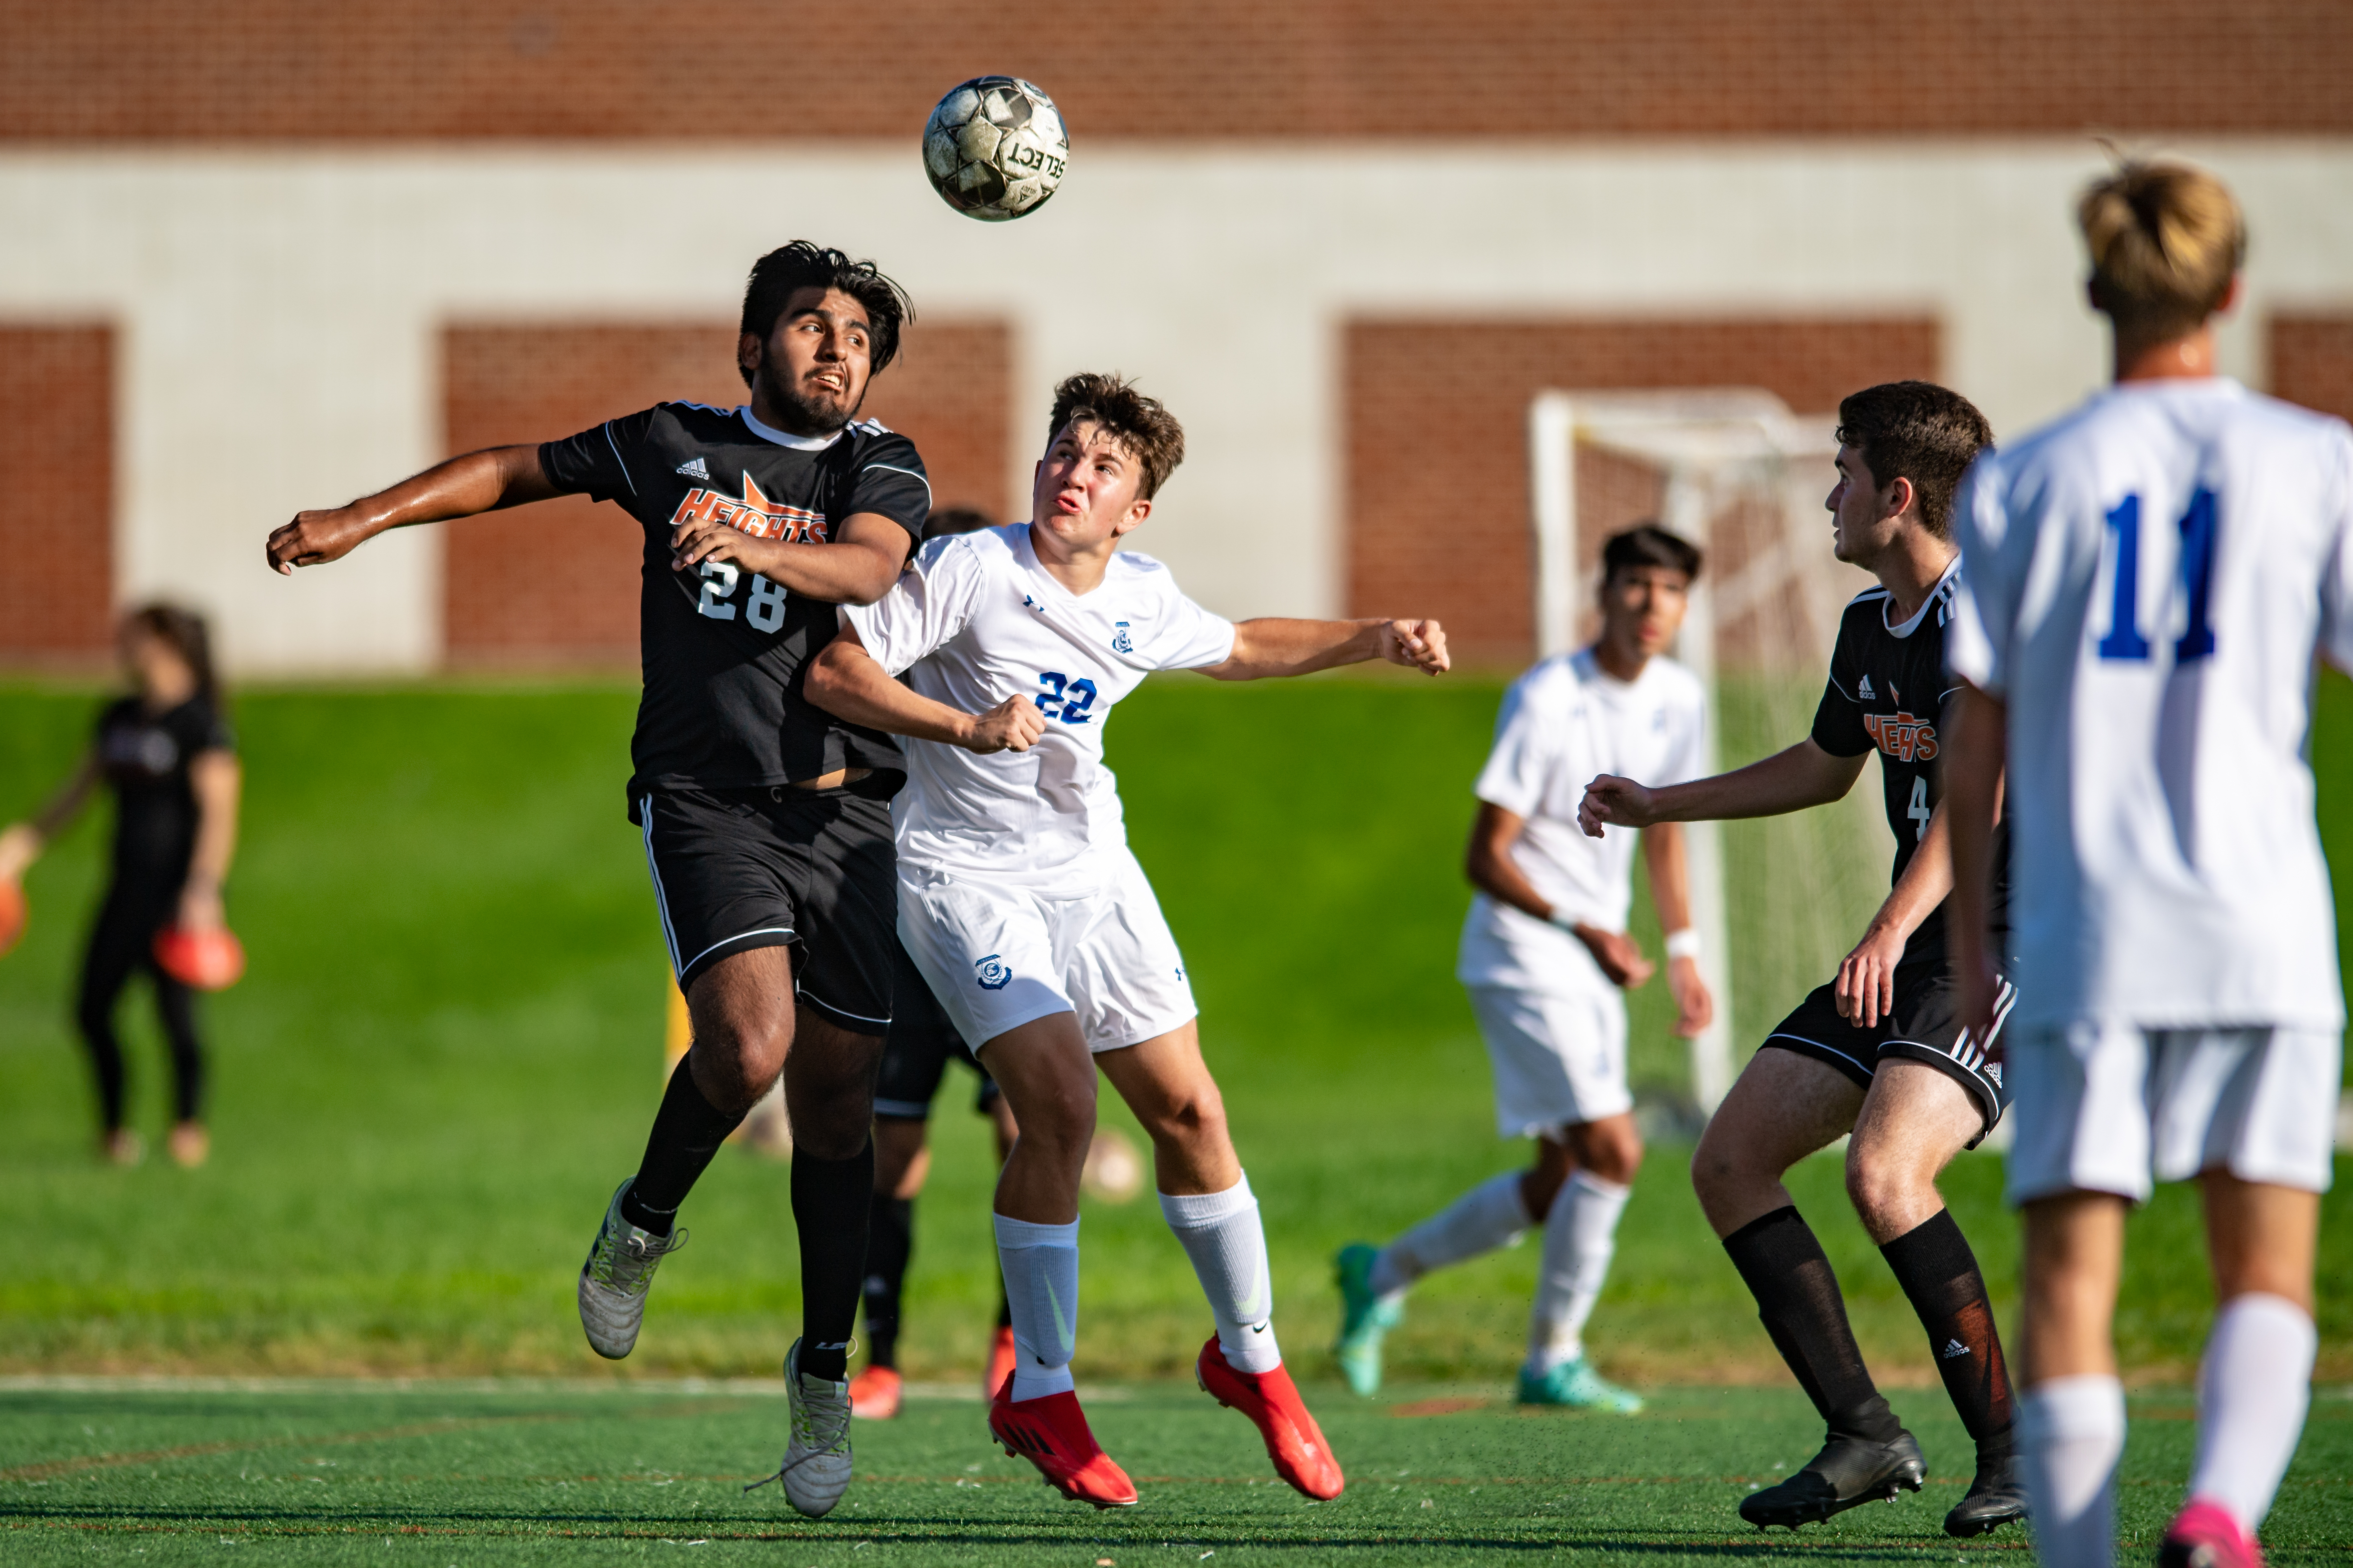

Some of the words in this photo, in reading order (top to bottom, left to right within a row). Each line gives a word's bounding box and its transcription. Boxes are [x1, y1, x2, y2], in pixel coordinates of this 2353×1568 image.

[1008, 143, 1066, 179] SELECT
[676, 467, 709, 481] adidas
[669, 488, 828, 545] HEIGHTS
[698, 561, 787, 634] 28
[2098, 490, 2216, 664] 11
[1035, 671, 1097, 725] 22
[1907, 775, 1930, 842] 4
[1984, 1065, 2002, 1089] adidas
[1943, 1346, 1970, 1358] adidas
